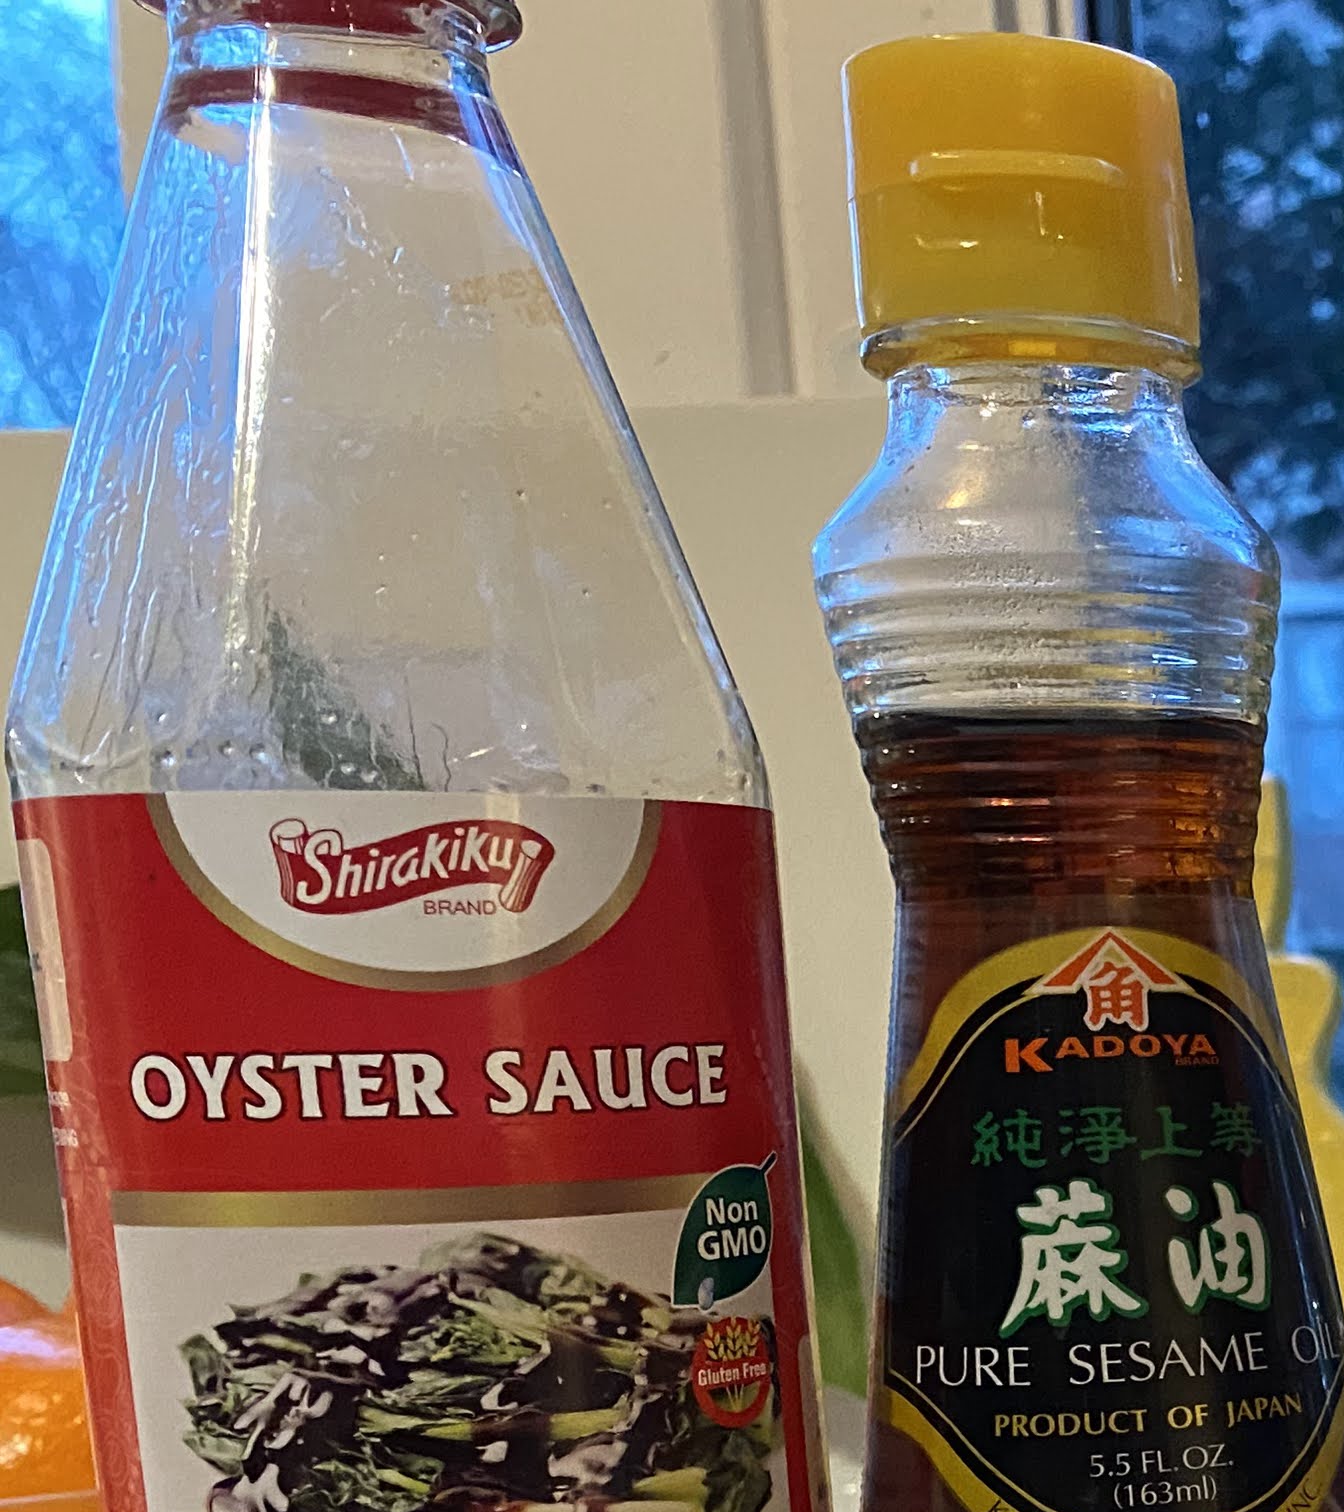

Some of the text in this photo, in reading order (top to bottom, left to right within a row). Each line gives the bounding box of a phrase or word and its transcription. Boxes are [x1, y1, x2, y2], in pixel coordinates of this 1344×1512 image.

[296, 826, 511, 905] Shirakiku
[423, 899, 497, 916] BRAND
[1004, 1034, 1217, 1073] KADOYA
[1176, 1055, 1219, 1066] BRAND
[131, 1043, 728, 1121] OYSTER SAUCE
[705, 1198, 759, 1225] Non
[697, 1227, 766, 1262] GMO
[917, 1324, 1342, 1388] PURE SESAME OIL
[698, 1362, 767, 1386] Gluten Free
[994, 1393, 1302, 1437] PRODUCT OF JAPAN
[1089, 1452, 1131, 1478] 5.5
[1114, 1475, 1217, 1510] (163ml)
